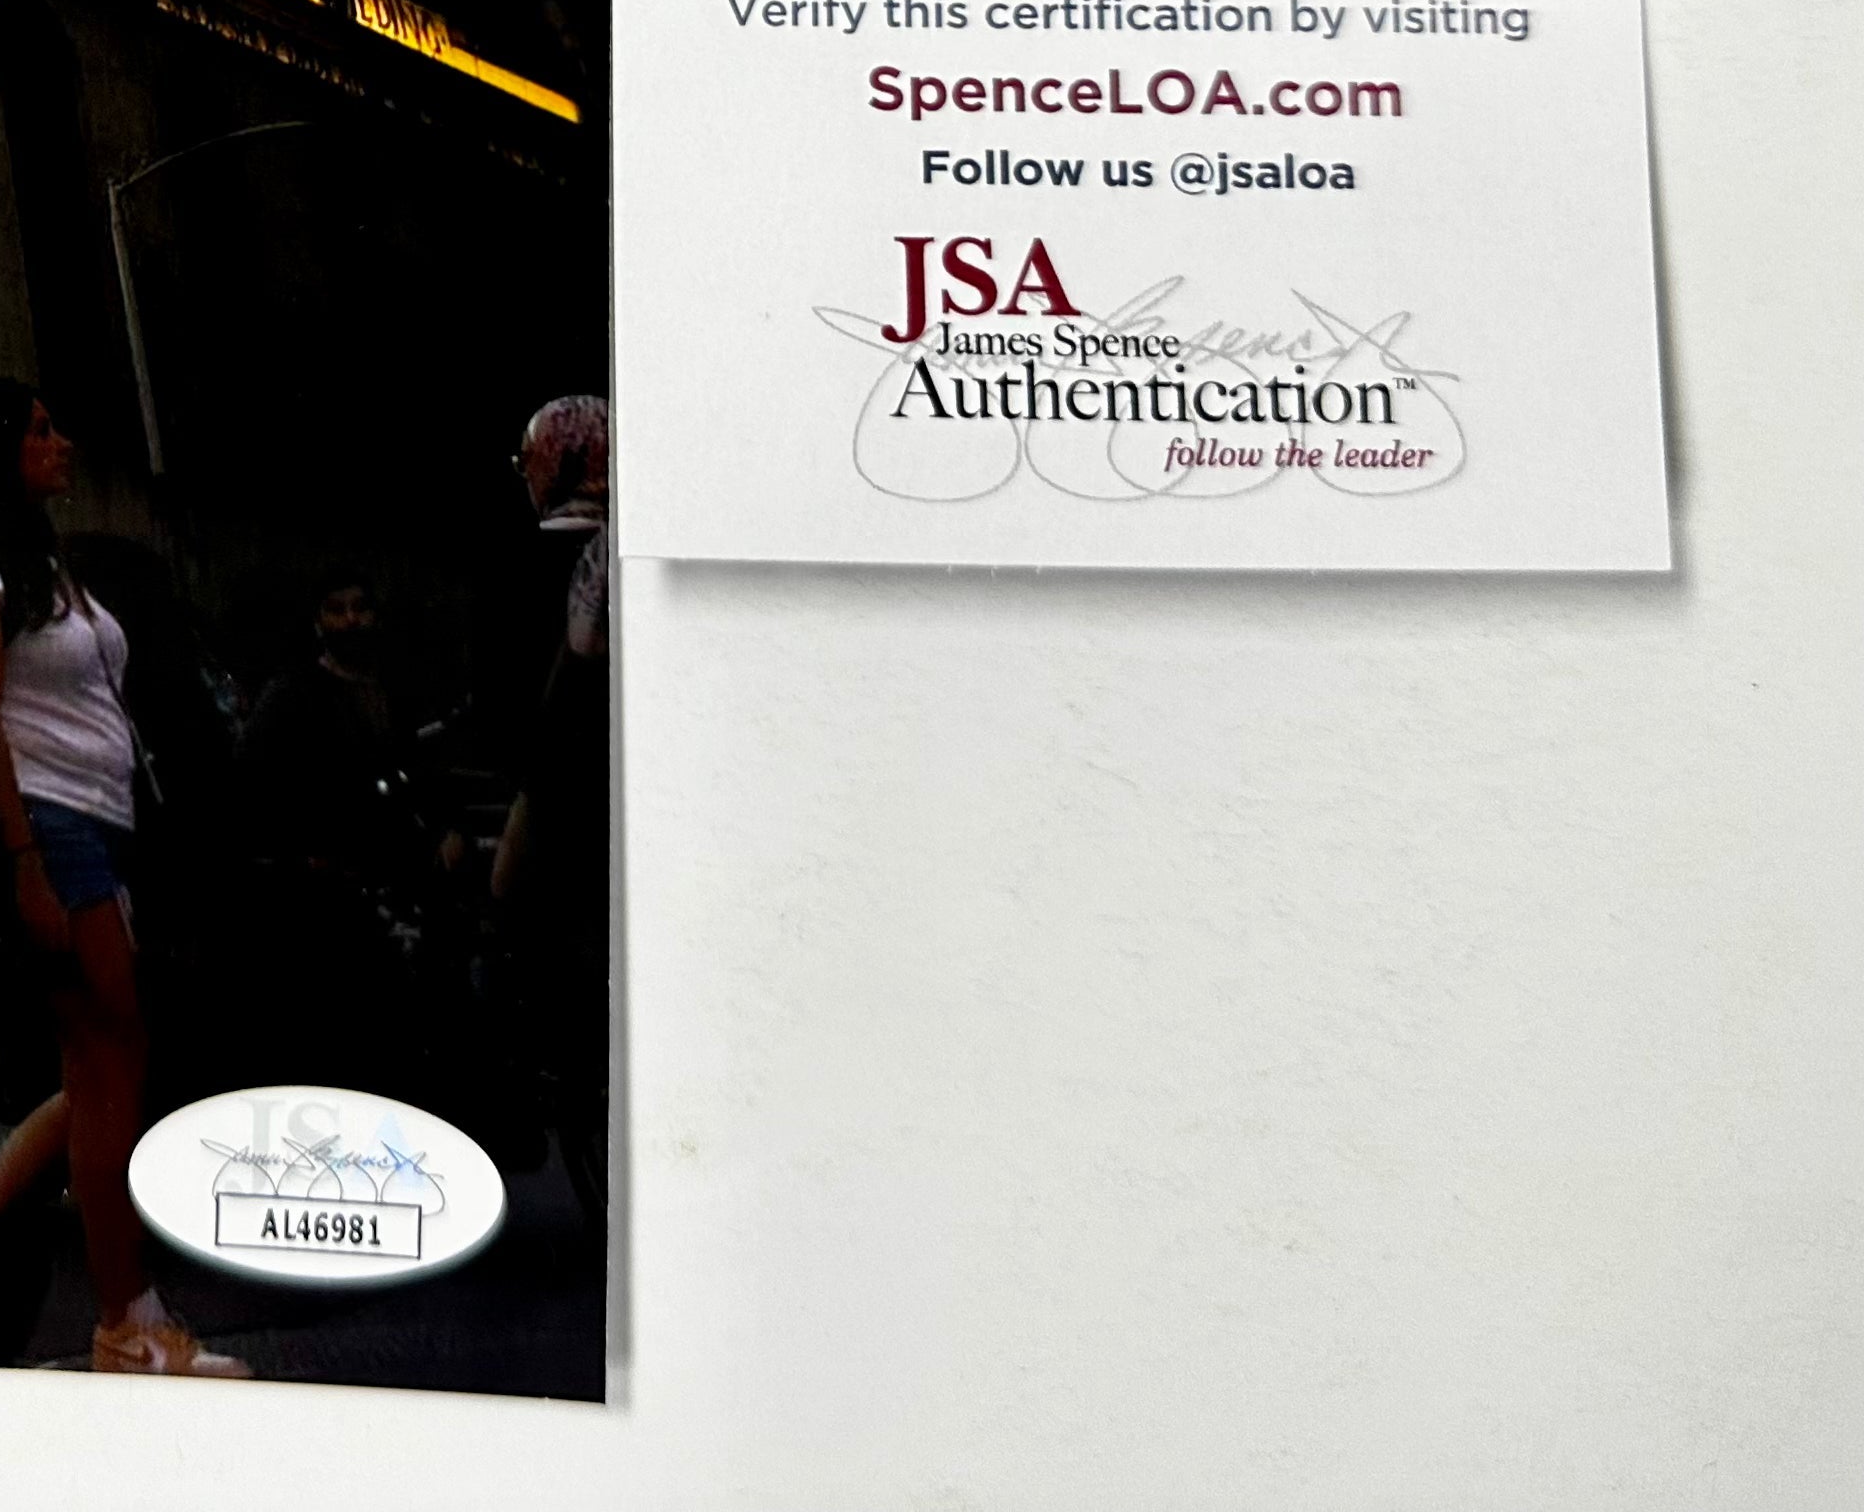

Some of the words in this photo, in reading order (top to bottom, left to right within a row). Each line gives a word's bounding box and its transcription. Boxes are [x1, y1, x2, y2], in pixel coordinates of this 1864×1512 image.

[869, 65, 1402, 122] SpenceLOA.com
[922, 149, 1085, 187] Follow
[1102, 160, 1154, 188] us
[1170, 152, 1356, 196] @jsaloa
[881, 236, 1084, 345] JSA
[935, 321, 1043, 357] James
[1053, 323, 1180, 367] Spence
[1164, 437, 1264, 473] follow
[1275, 437, 1324, 471] the
[1334, 438, 1434, 469] leader
[259, 1206, 382, 1248] AL46981
